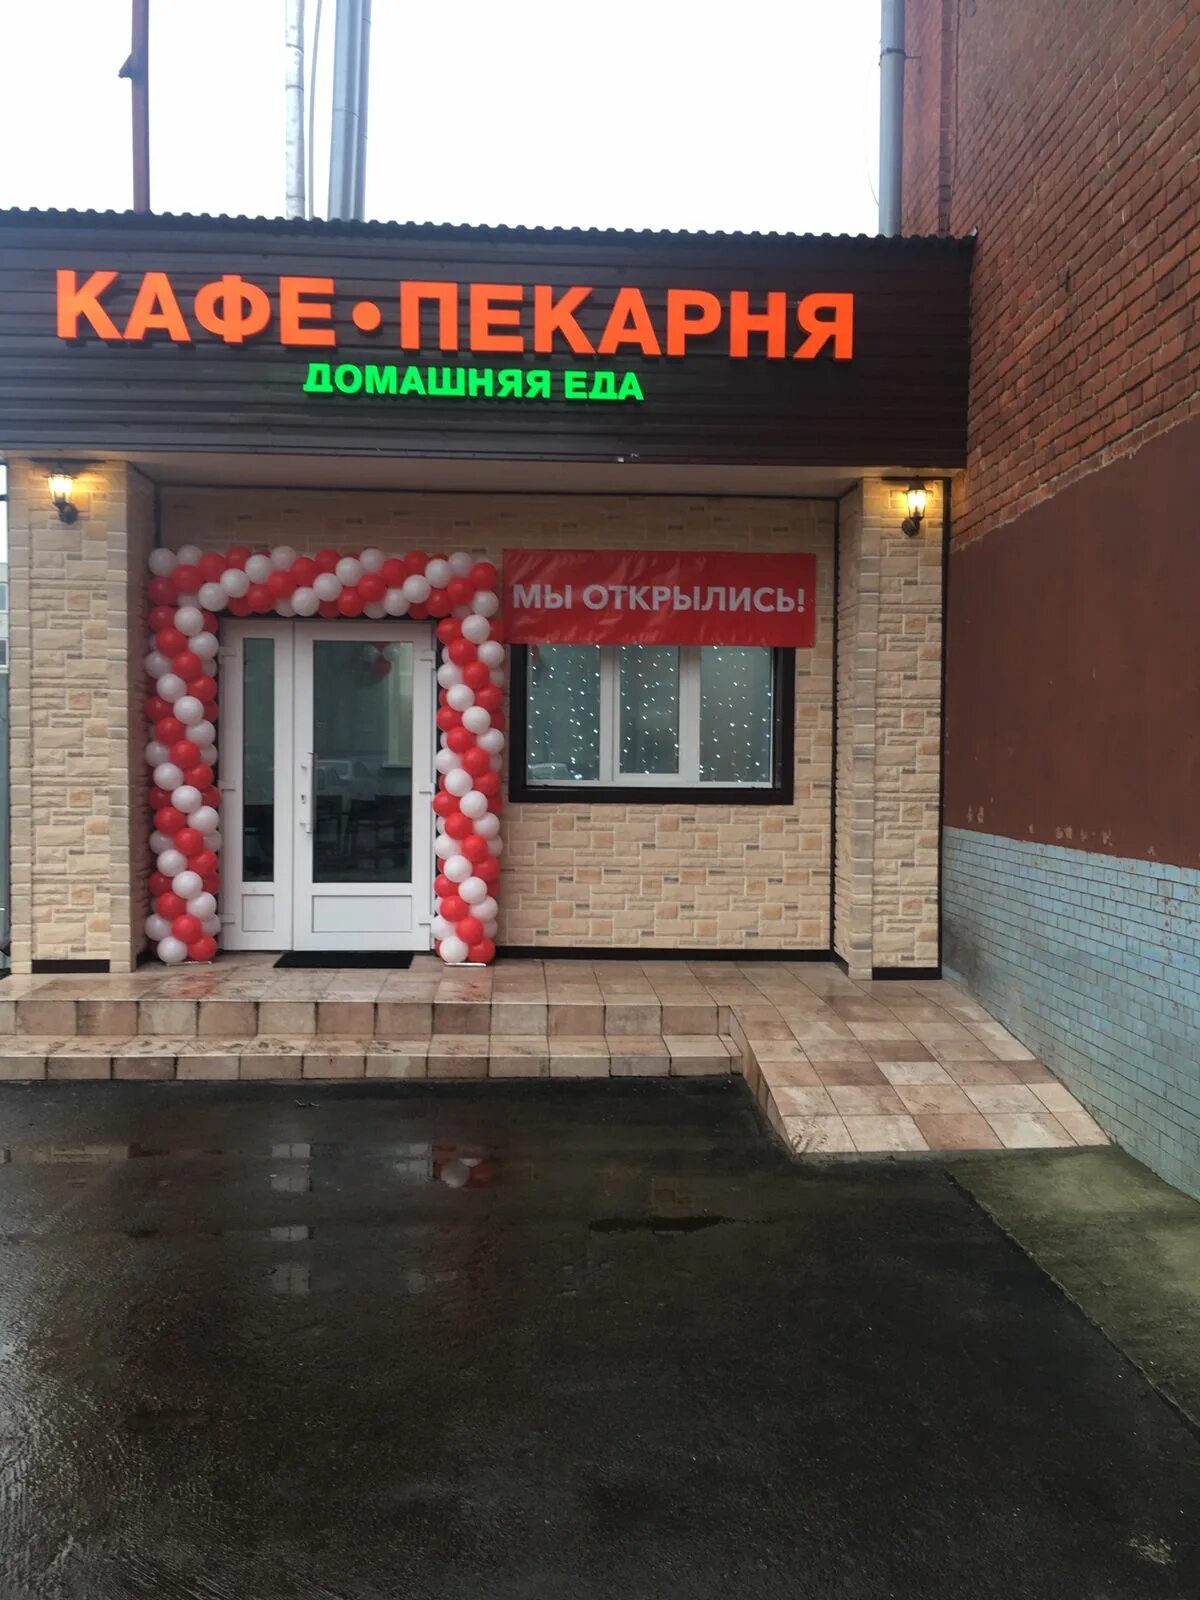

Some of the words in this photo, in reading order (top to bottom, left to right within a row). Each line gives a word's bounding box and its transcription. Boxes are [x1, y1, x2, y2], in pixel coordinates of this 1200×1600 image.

[55, 269, 336, 350] КАФЕ
[400, 281, 855, 360] ПЕКАРНЯ
[302, 362, 552, 400] ДОМАШНЯЯ
[564, 369, 646, 403] ЕДА
[512, 583, 572, 610] МЫ
[582, 584, 807, 614] ОТКРЫЛИСЬ!
